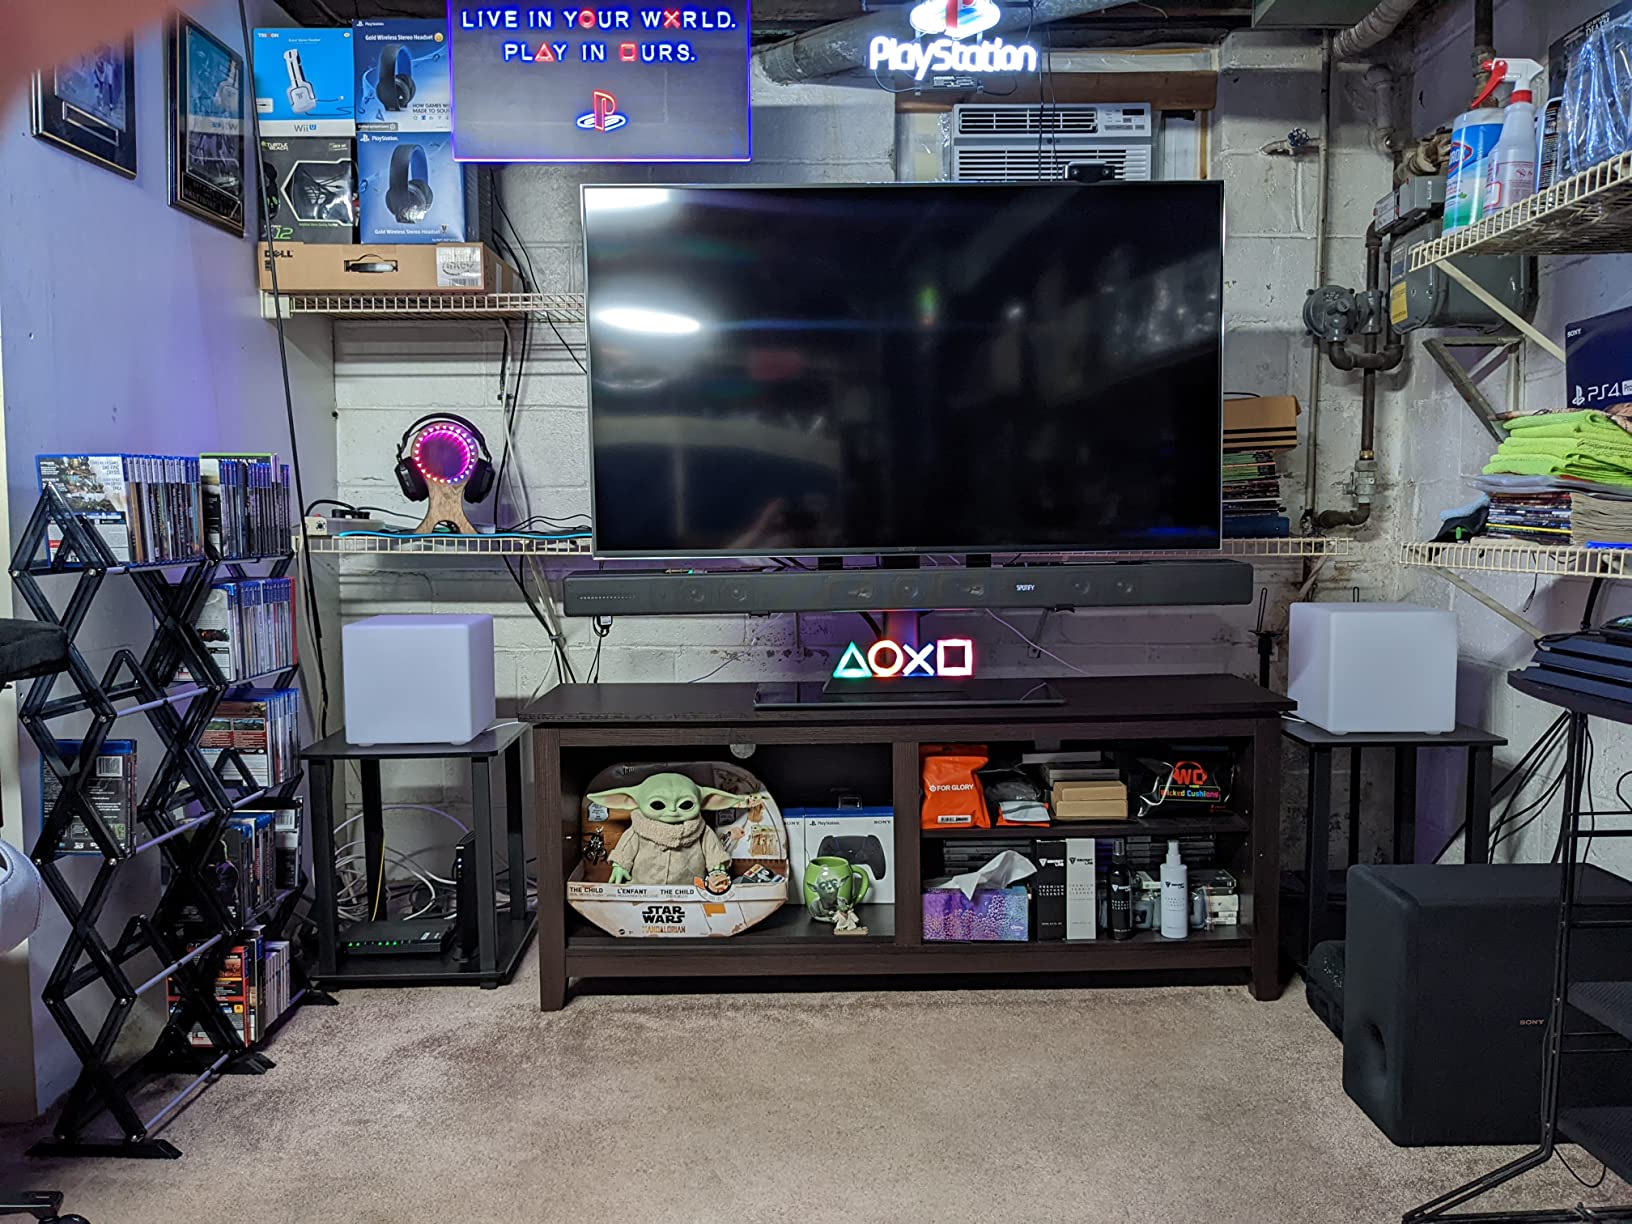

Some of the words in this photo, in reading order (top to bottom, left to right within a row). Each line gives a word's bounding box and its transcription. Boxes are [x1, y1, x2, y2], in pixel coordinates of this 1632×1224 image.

[461, 10, 518, 29] LIVE
[528, 10, 552, 29] IN
[563, 9, 629, 29] YOUR
[503, 42, 567, 62] PLAY
[581, 42, 606, 61] IN
[869, 35, 1037, 81] PlayStation
[1567, 328, 1581, 337] SONY
[1588, 382, 1620, 402] PS4
[951, 783, 974, 791] GLORY
[1186, 790, 1219, 798] Cushions
[642, 906, 685, 914] STAR
[642, 915, 685, 923] WARS
